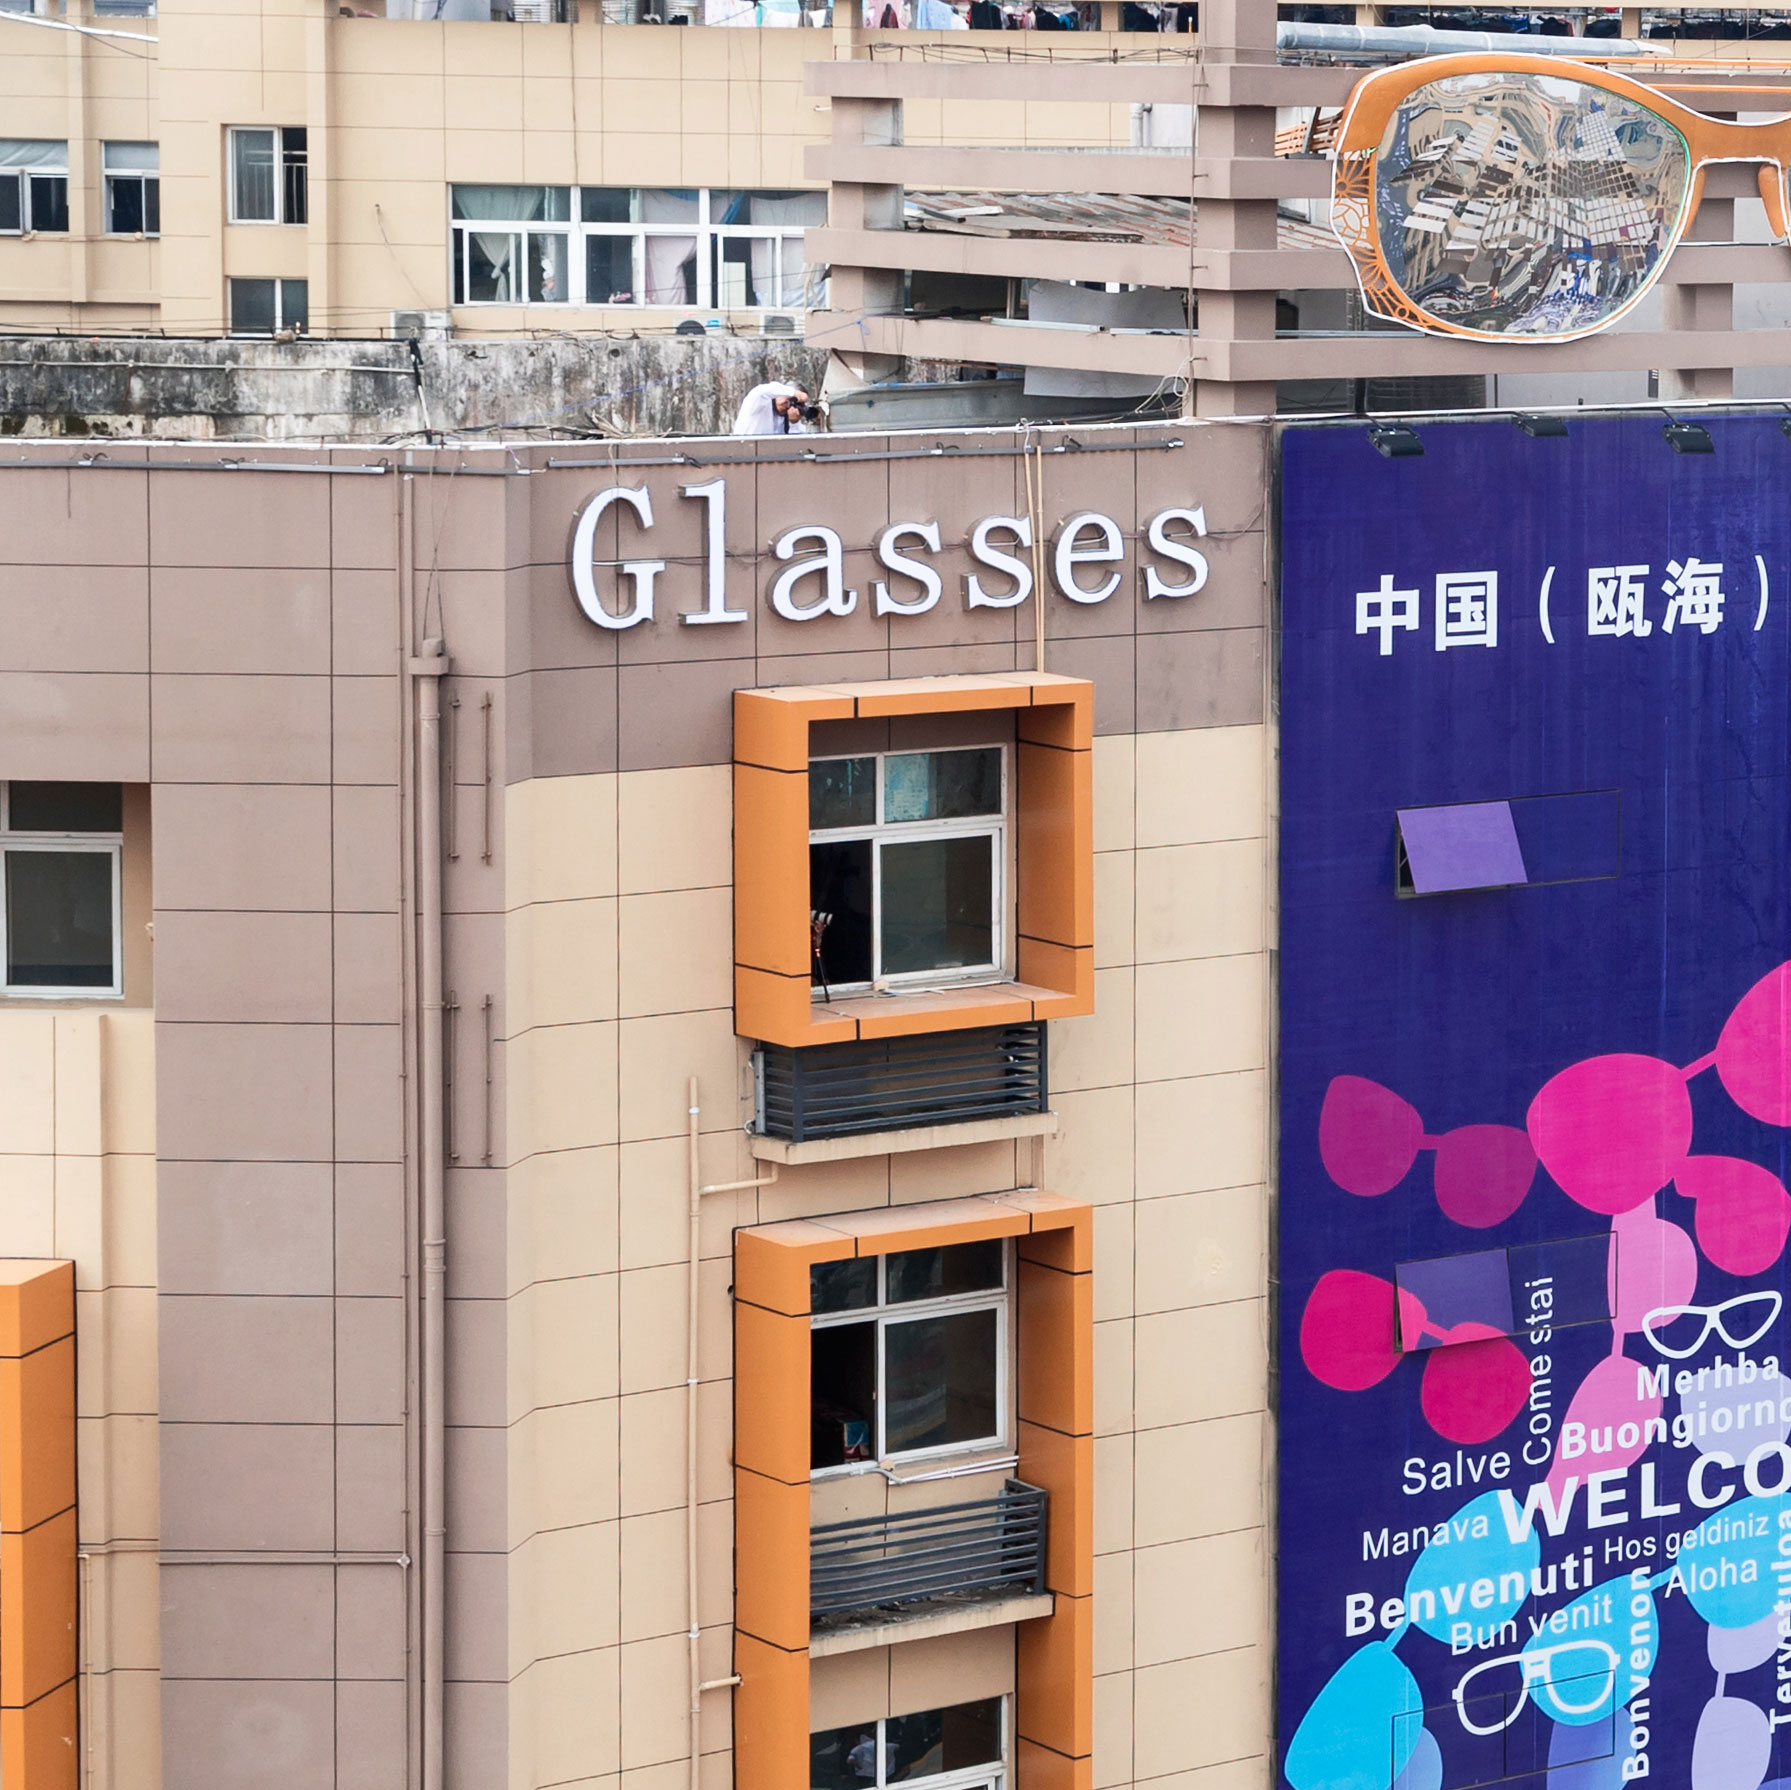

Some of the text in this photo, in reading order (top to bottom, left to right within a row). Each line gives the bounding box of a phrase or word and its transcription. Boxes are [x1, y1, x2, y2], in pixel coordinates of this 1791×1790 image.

[569, 477, 1209, 629] Glasses
[1523, 1276, 1553, 1465] Come stai
[1637, 1353, 1780, 1400] Merhba
[1402, 1451, 1511, 1495] Salve
[1362, 1514, 1490, 1561] Manava
[1605, 1512, 1769, 1564] Hos geldiniz
[1345, 1546, 1594, 1637] Benvenuti
[1664, 1558, 1758, 1598] Aloha
[1451, 1594, 1613, 1656] Bun venit
[1622, 1566, 1651, 1781] Bonvenon
